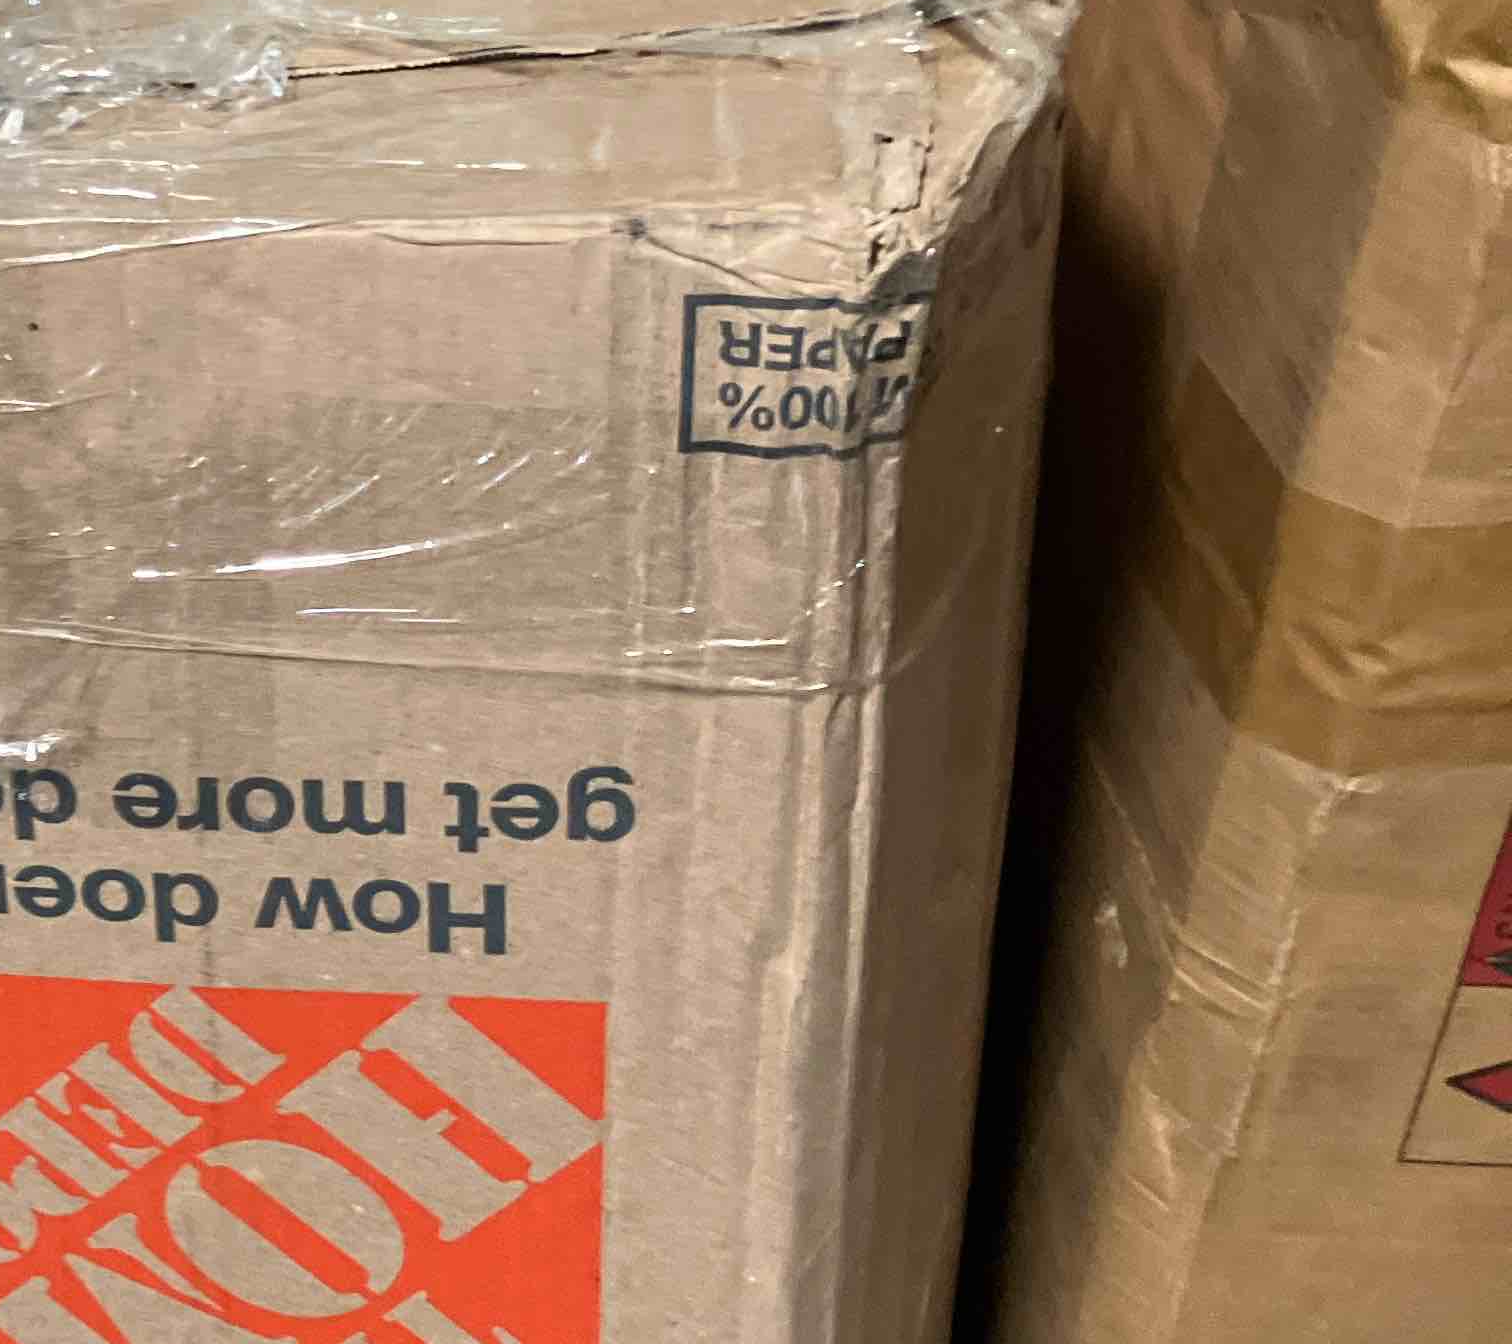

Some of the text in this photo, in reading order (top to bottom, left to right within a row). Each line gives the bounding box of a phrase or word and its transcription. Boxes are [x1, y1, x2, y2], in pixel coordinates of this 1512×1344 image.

[718, 318, 914, 372] PAPER
[112, 771, 407, 838] more
[444, 766, 637, 854] get
[254, 877, 508, 956] How
